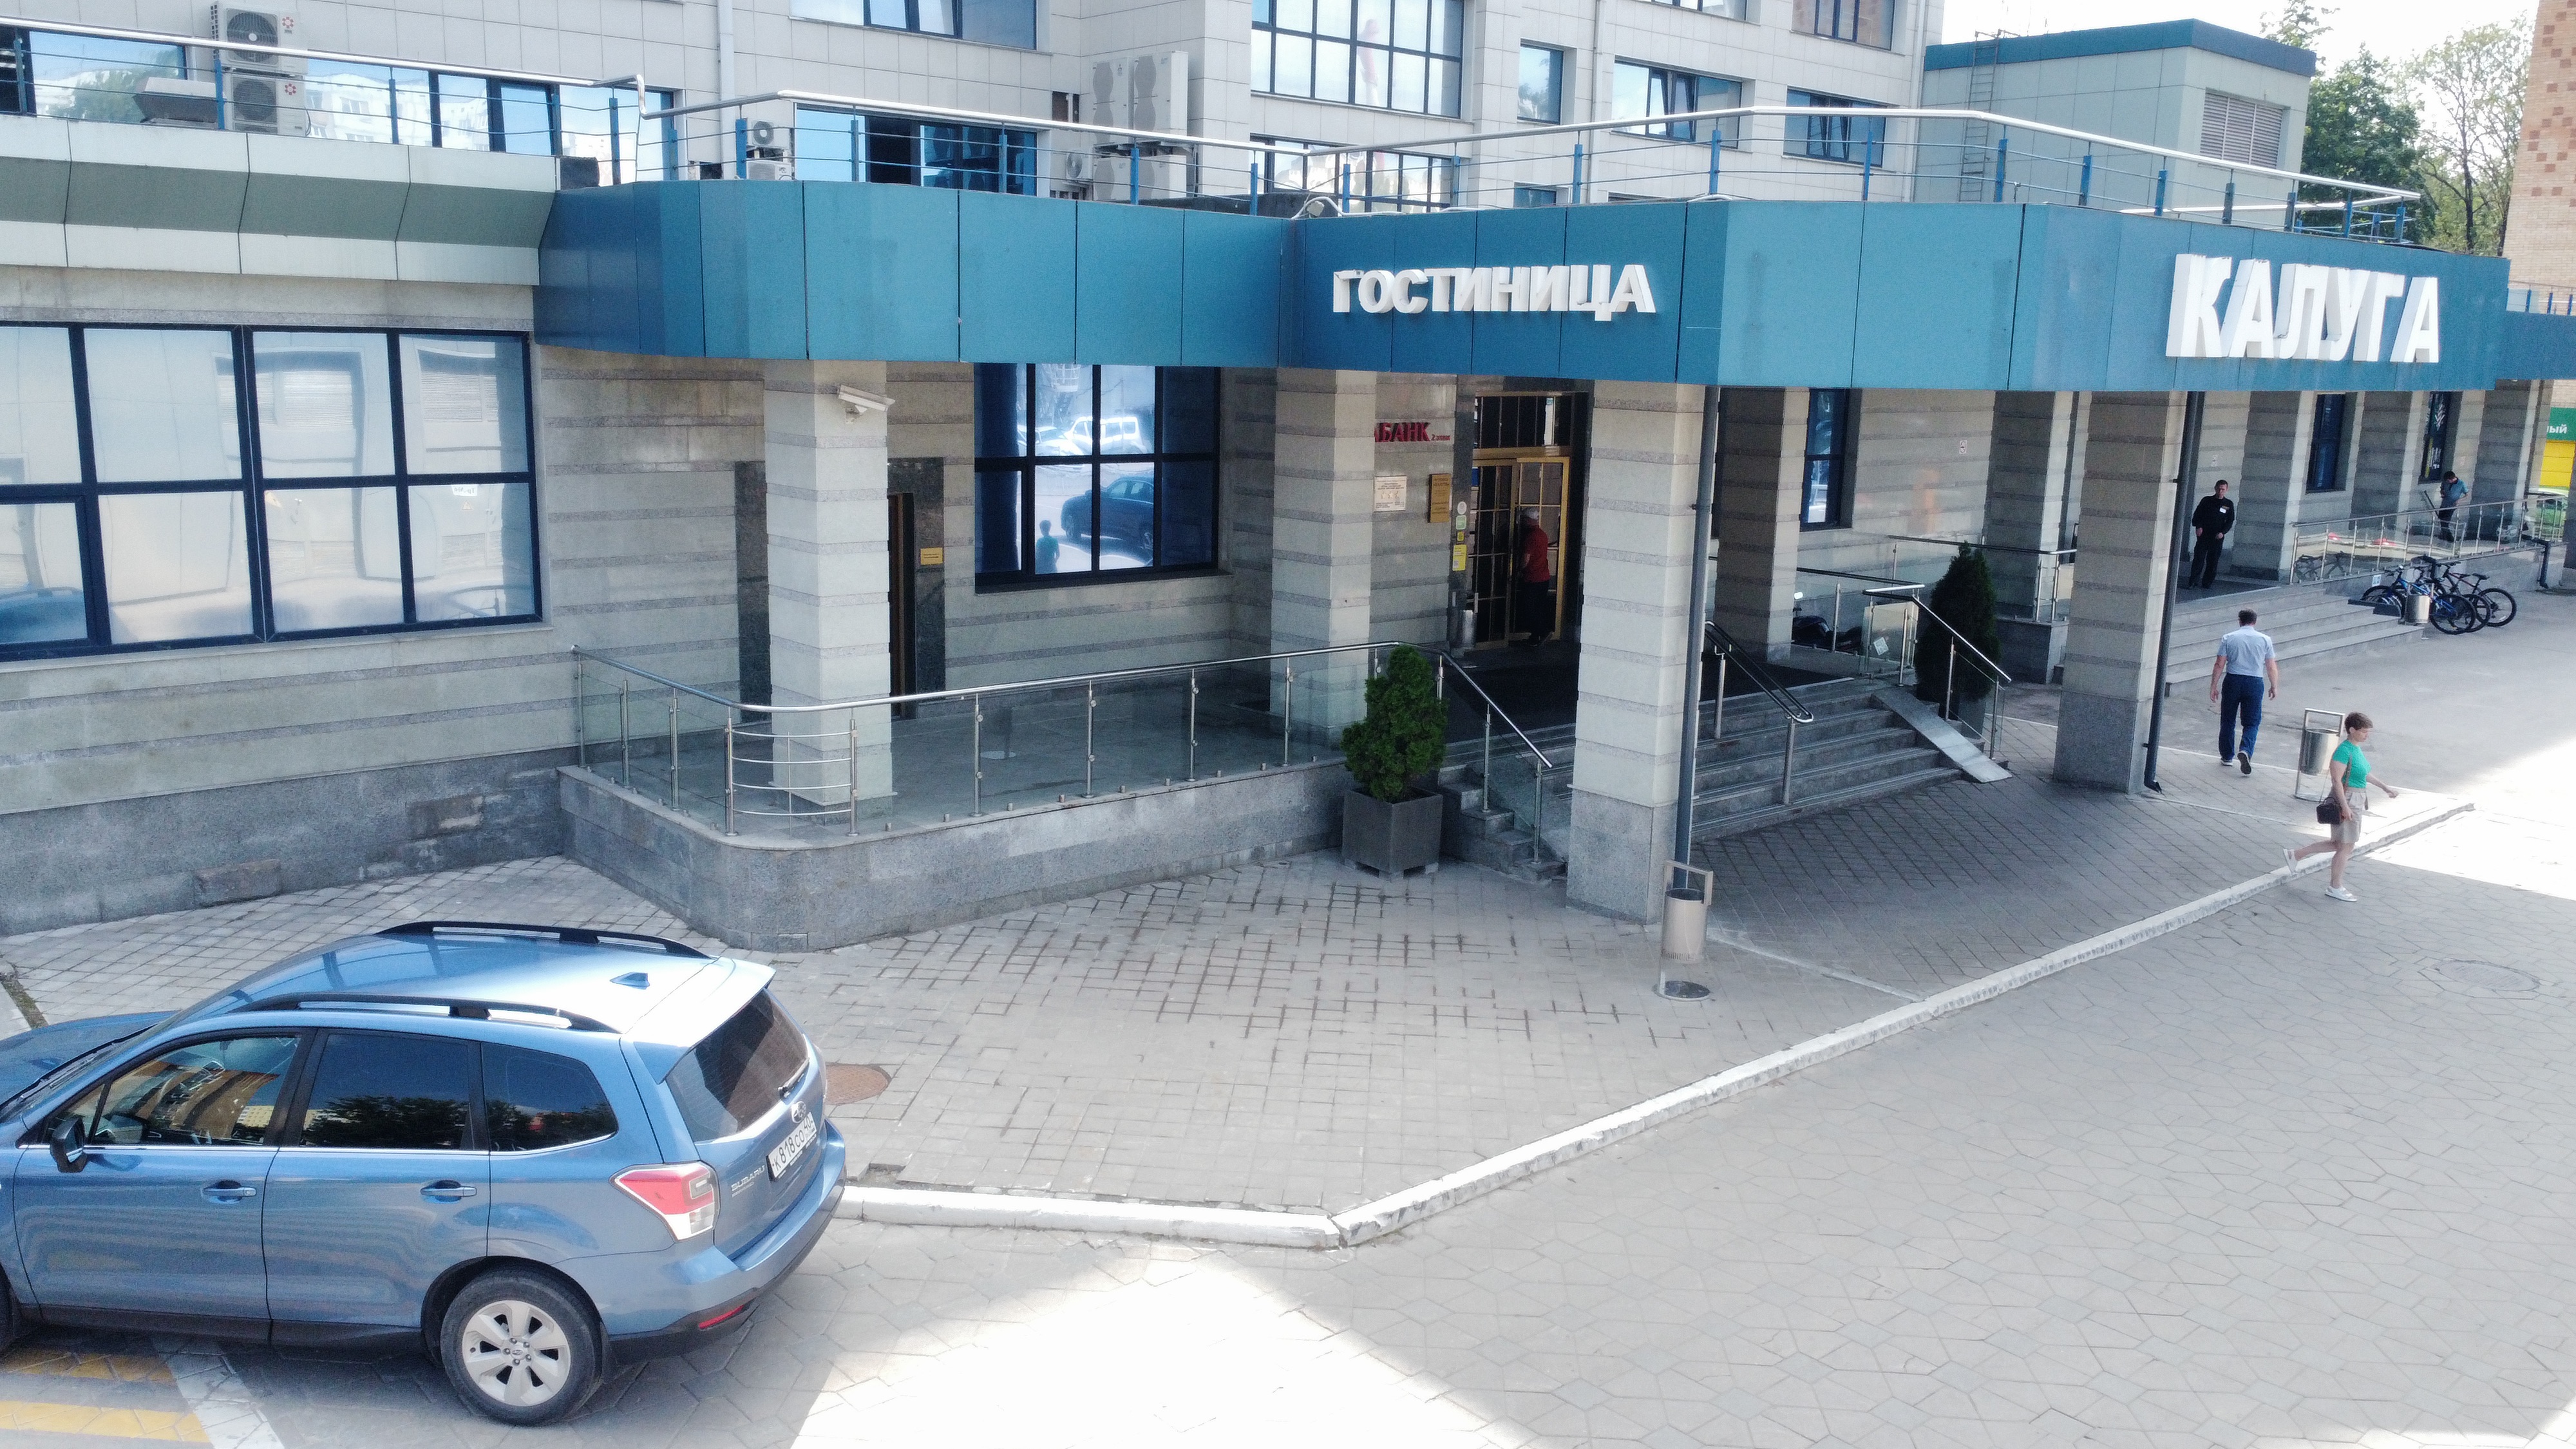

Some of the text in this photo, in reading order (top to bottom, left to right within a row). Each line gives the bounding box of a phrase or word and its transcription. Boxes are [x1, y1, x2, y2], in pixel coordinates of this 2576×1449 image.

[1333, 265, 1656, 321] ГОСТИНИЦА
[2166, 254, 2439, 363] КАЛУГА
[731, 1164, 765, 1192] SUBARU
